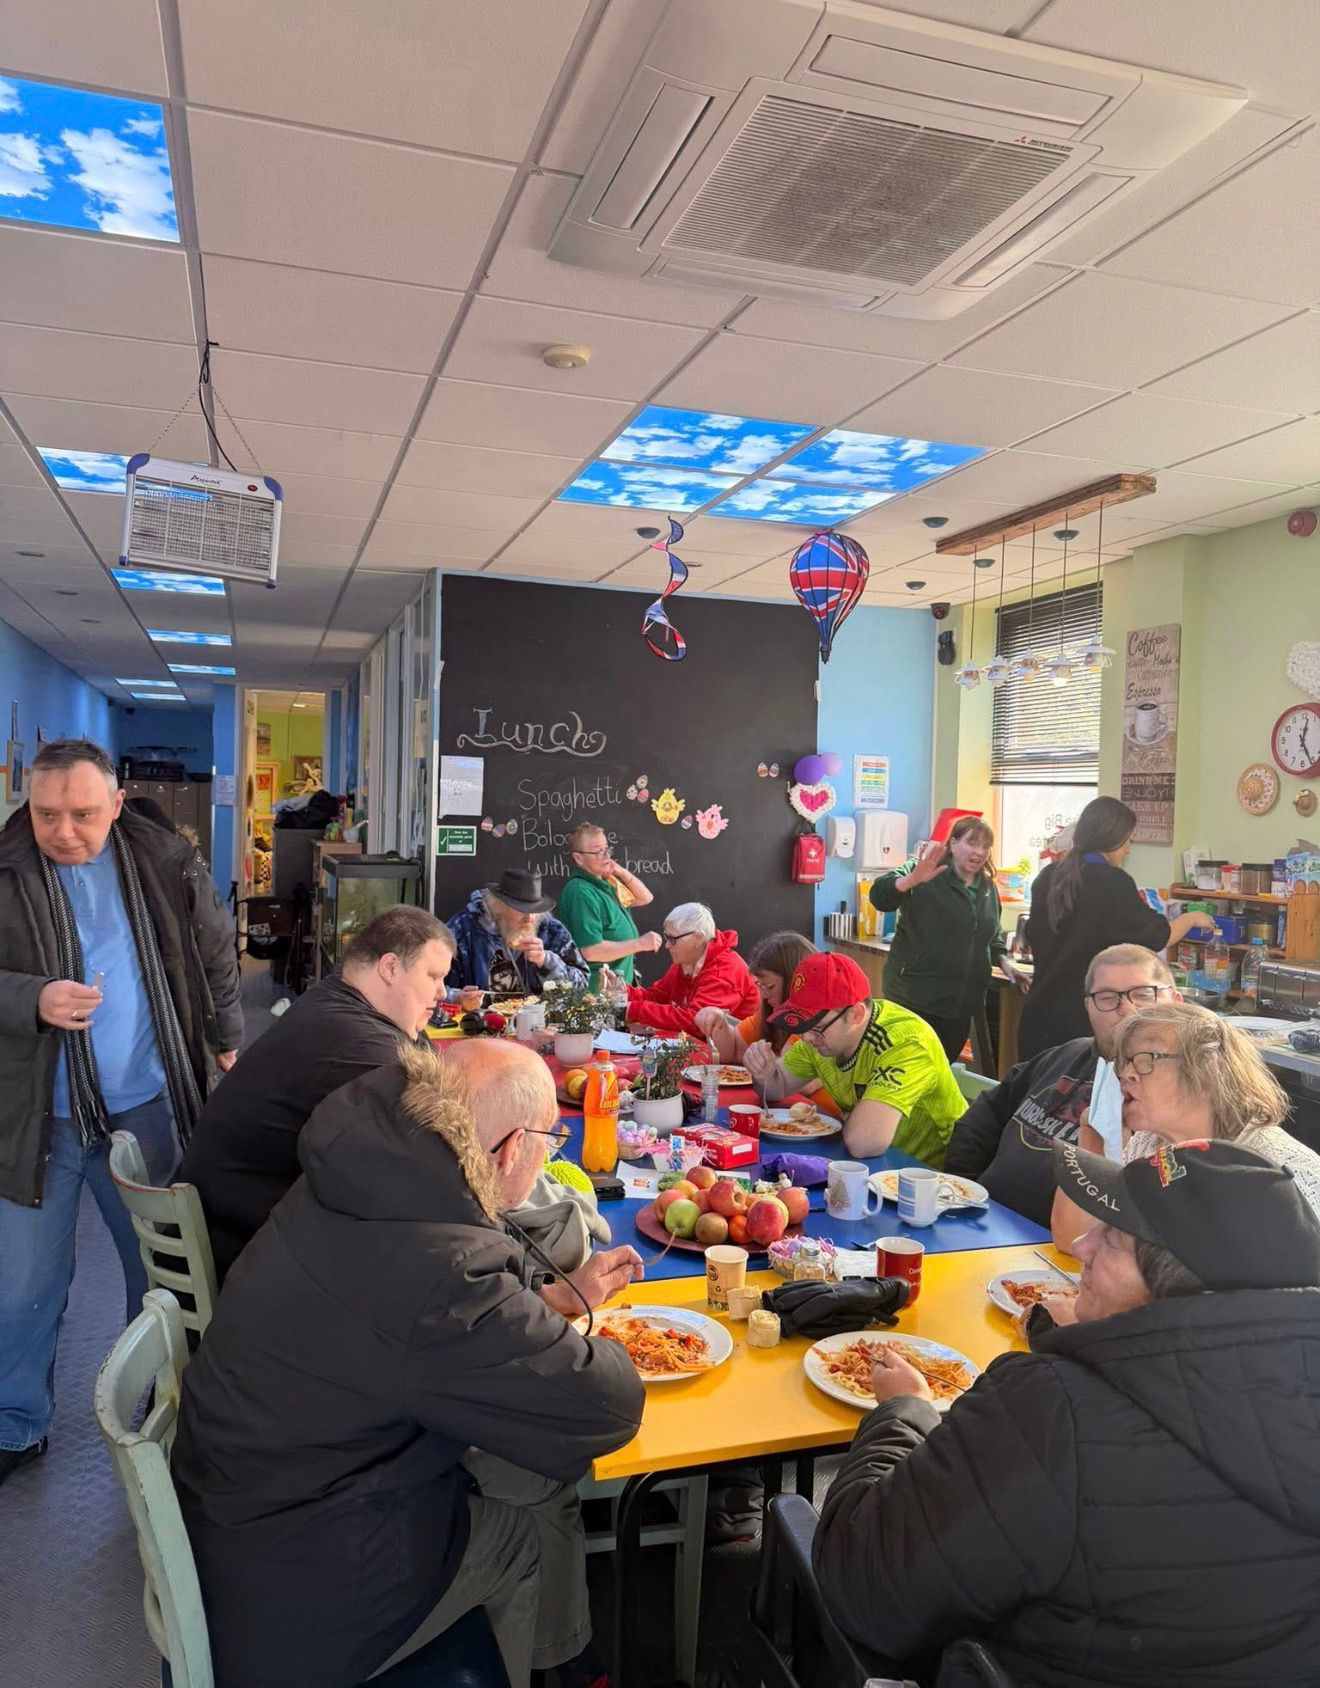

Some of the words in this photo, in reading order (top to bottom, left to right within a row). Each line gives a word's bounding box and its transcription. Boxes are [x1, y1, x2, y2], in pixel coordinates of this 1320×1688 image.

[1128, 631, 1169, 657] Coffee
[1126, 682, 1162, 701] Espresso
[457, 707, 607, 757] Lunch
[1281, 736, 1286, 744] 9
[1285, 725, 1291, 733] 10
[1291, 756, 1297, 764] 7
[1300, 760, 1305, 768] 6
[517, 776, 622, 822] Spaghetti
[522, 817, 619, 855] Boloe
[625, 847, 674, 875] bread
[1063, 1142, 1120, 1211] PORTUGAL
